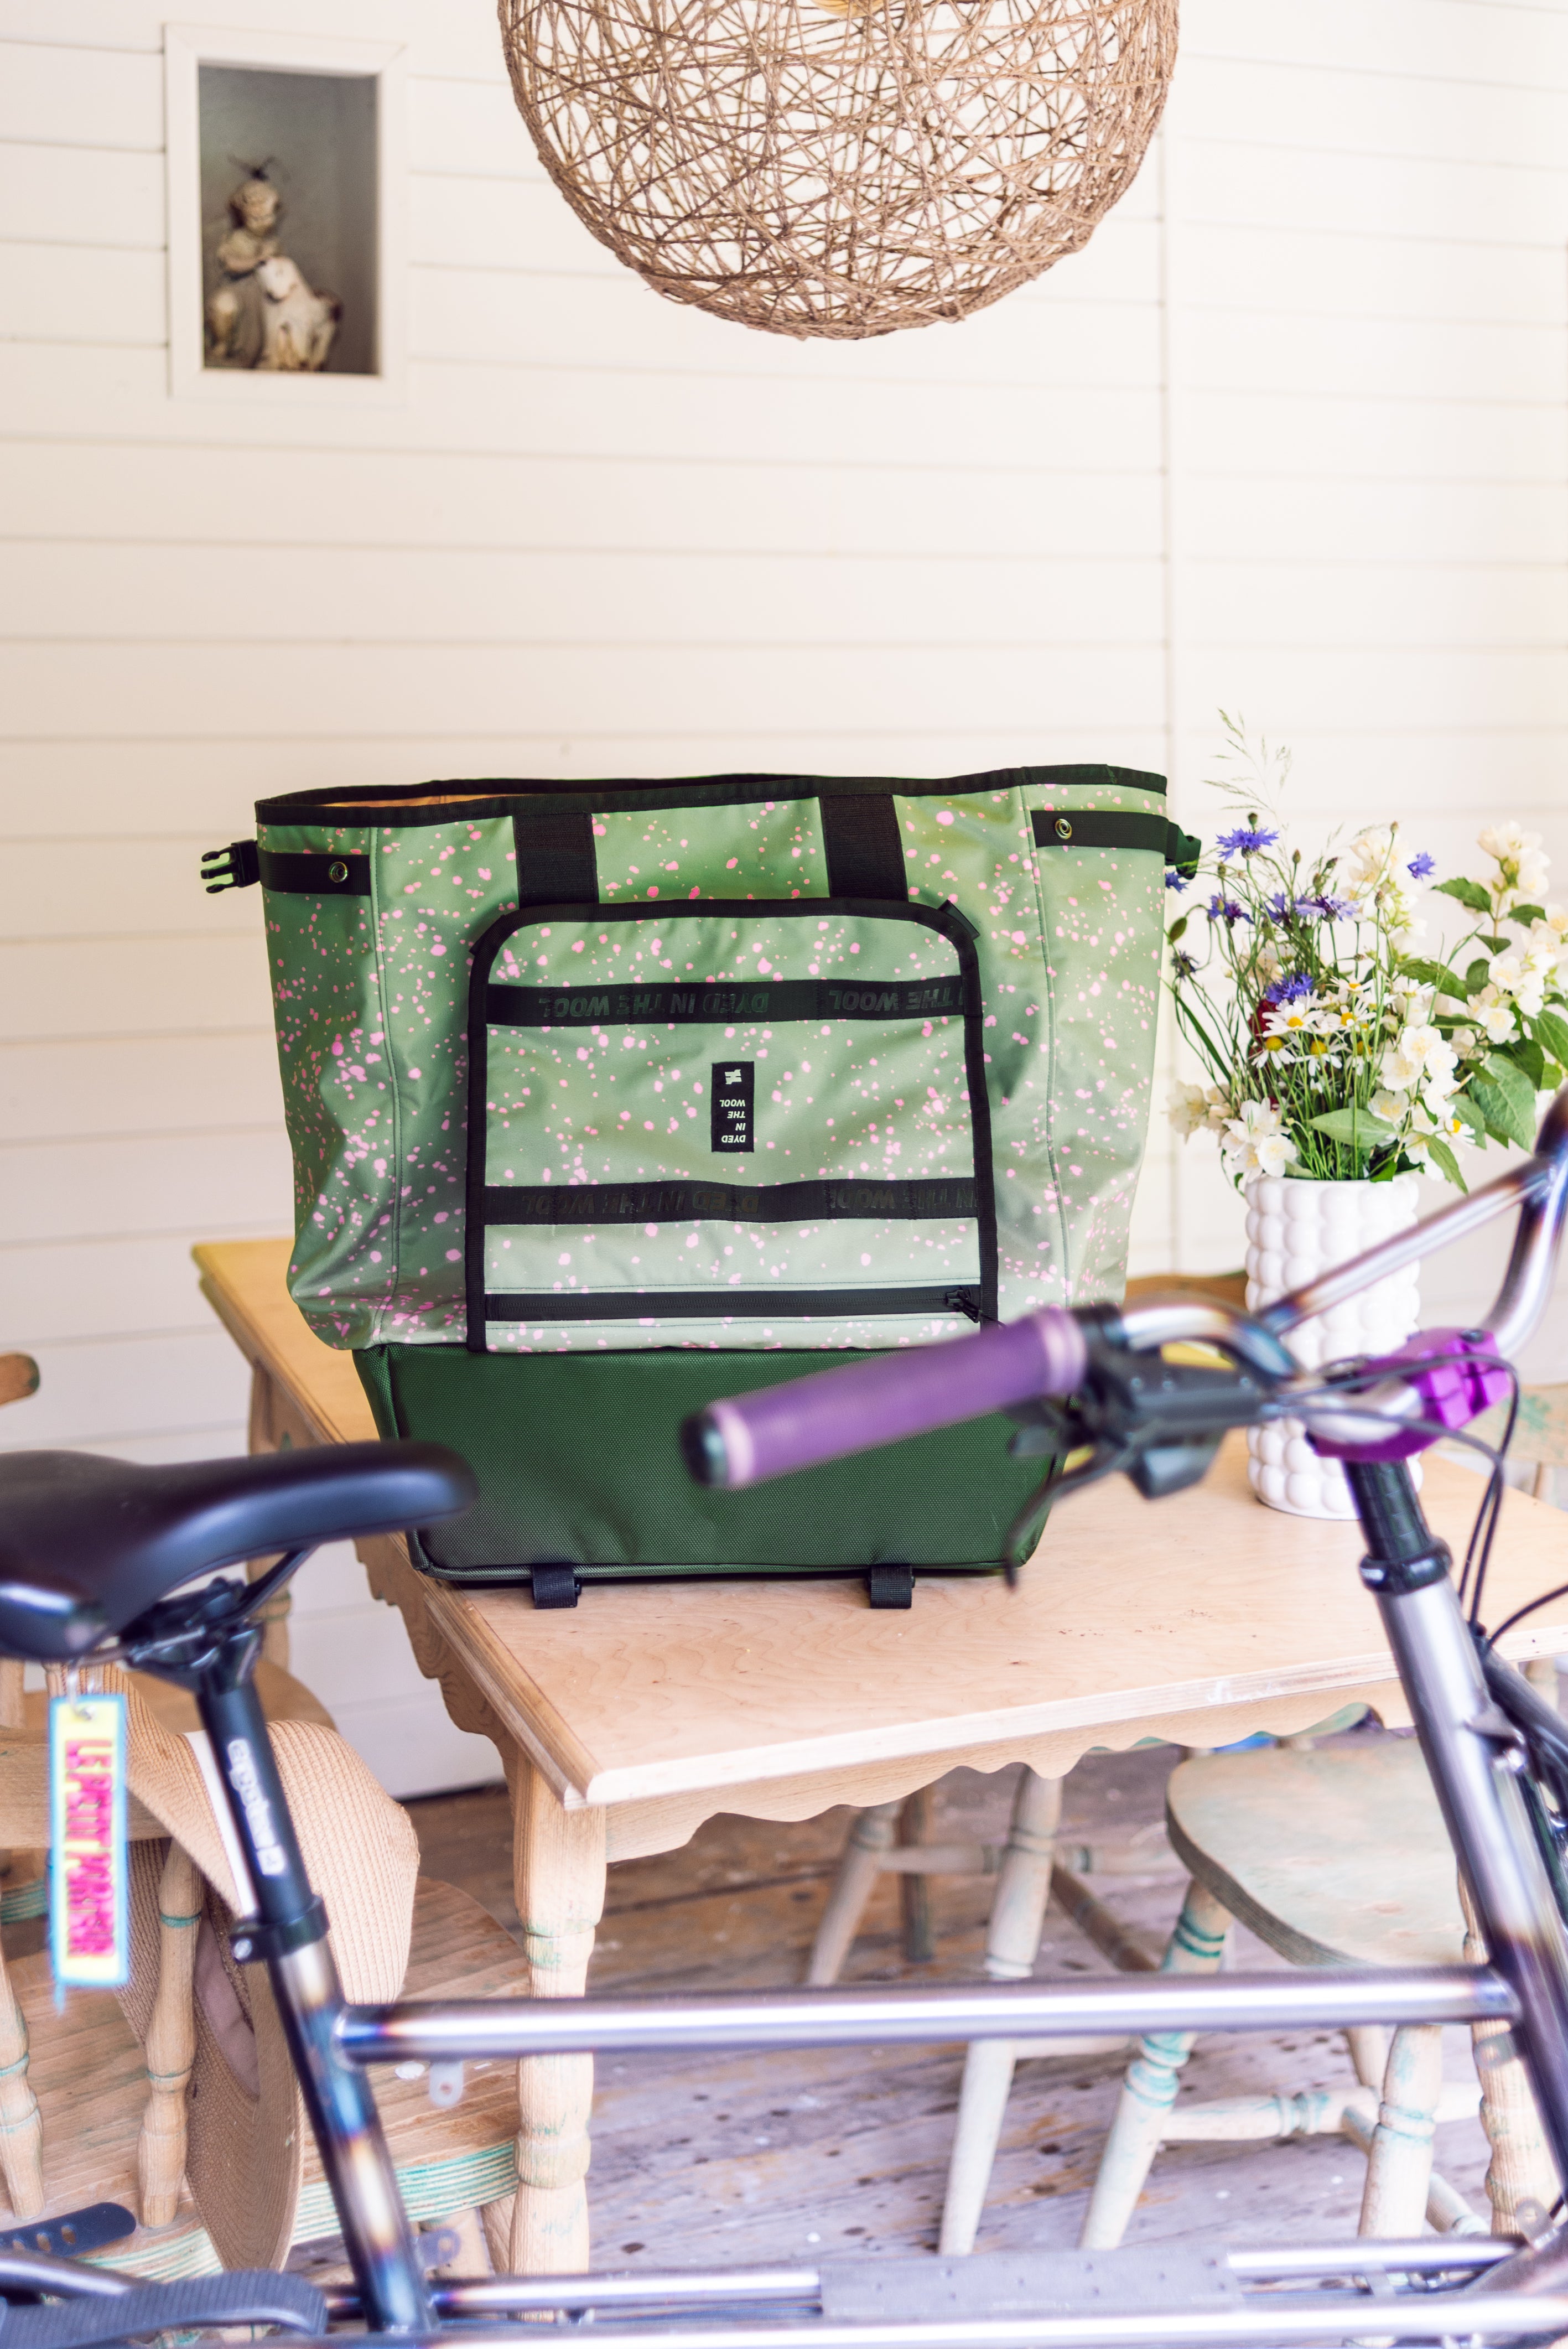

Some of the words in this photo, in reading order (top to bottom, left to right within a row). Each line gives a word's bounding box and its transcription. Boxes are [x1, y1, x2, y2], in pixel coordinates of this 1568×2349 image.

[538, 995, 610, 1018] WOOL
[616, 994, 663, 1015] THE
[670, 993, 696, 1014] IN
[703, 992, 769, 1014] DYED
[829, 990, 900, 1012] WOOL
[906, 987, 953, 1010] THE
[719, 1099, 746, 1107] WOOL
[735, 1122, 746, 1131] IN
[721, 1135, 746, 1143] DYED
[658, 1190, 687, 1212] IN
[65, 1739, 112, 1769] LE
[65, 1773, 113, 1848] PETIT
